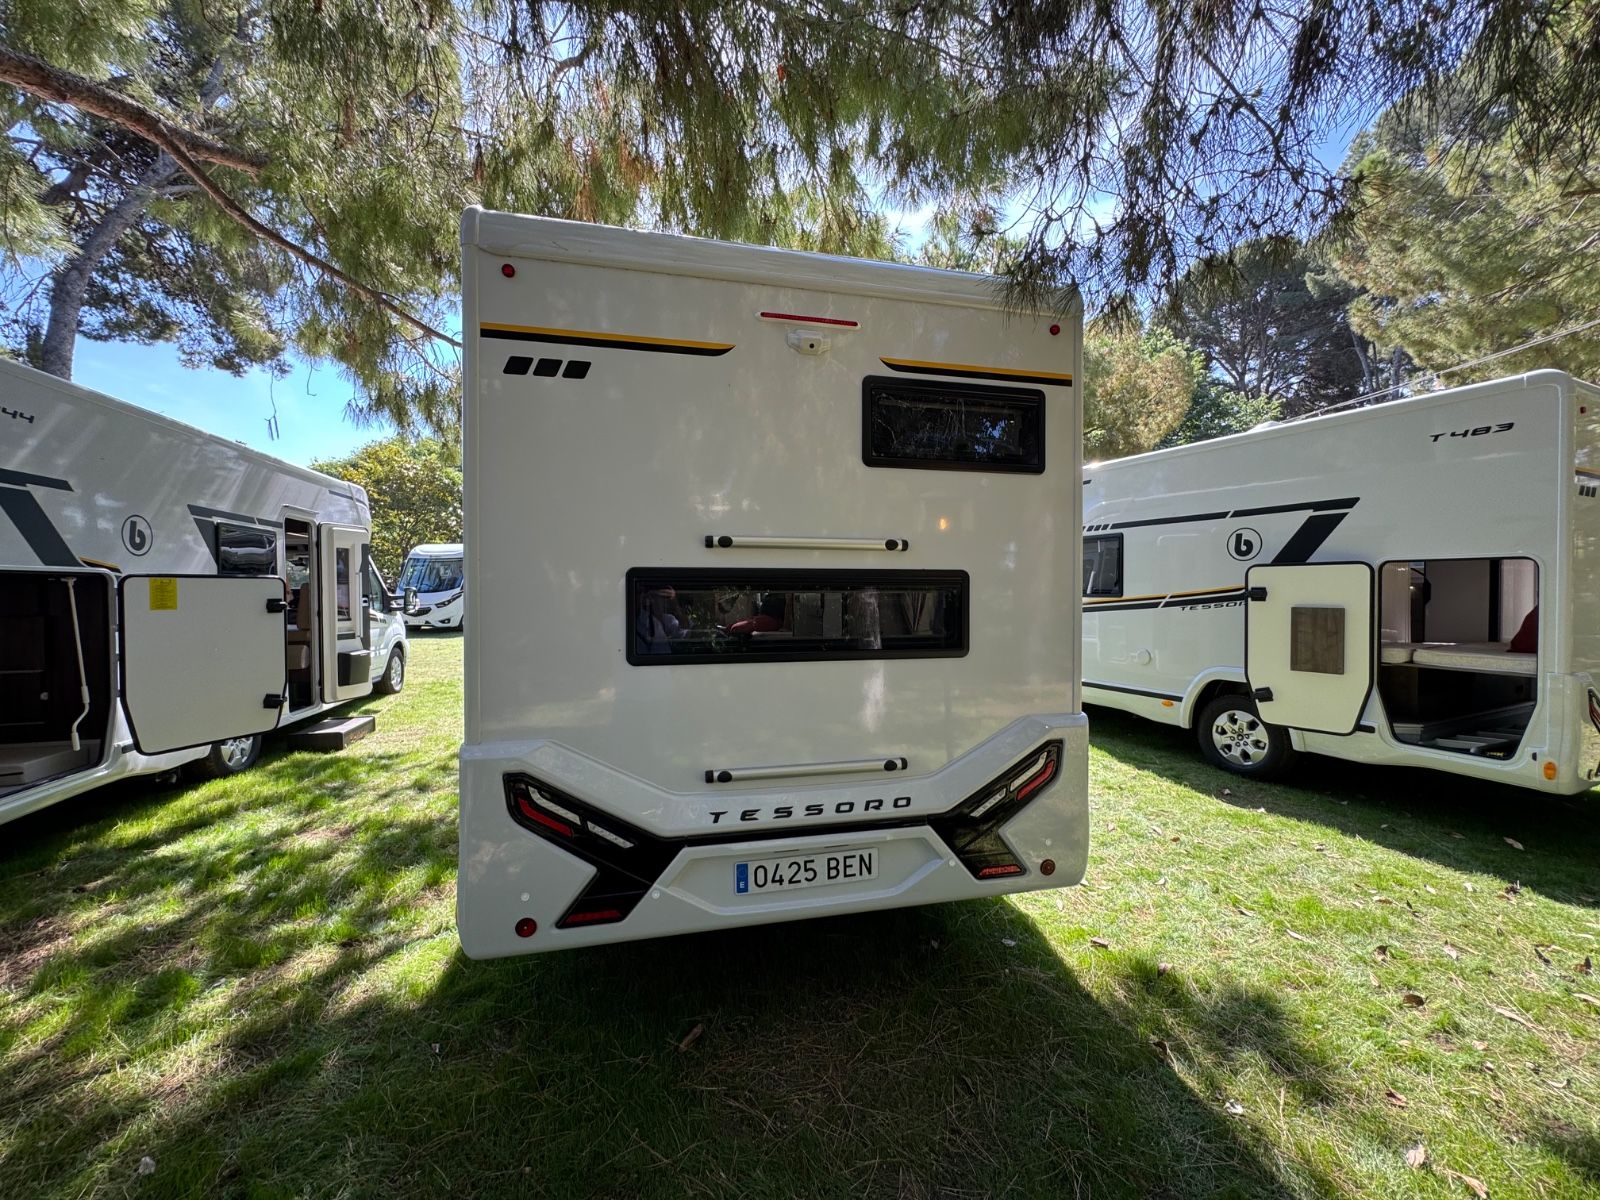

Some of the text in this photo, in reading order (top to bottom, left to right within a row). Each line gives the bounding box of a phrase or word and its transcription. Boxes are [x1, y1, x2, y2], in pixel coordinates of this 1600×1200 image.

[128, 518, 148, 552] b
[1233, 531, 1255, 559] b
[708, 796, 912, 824] TESSORO
[753, 852, 873, 888] 0425 BEN
[739, 881, 745, 889] E
